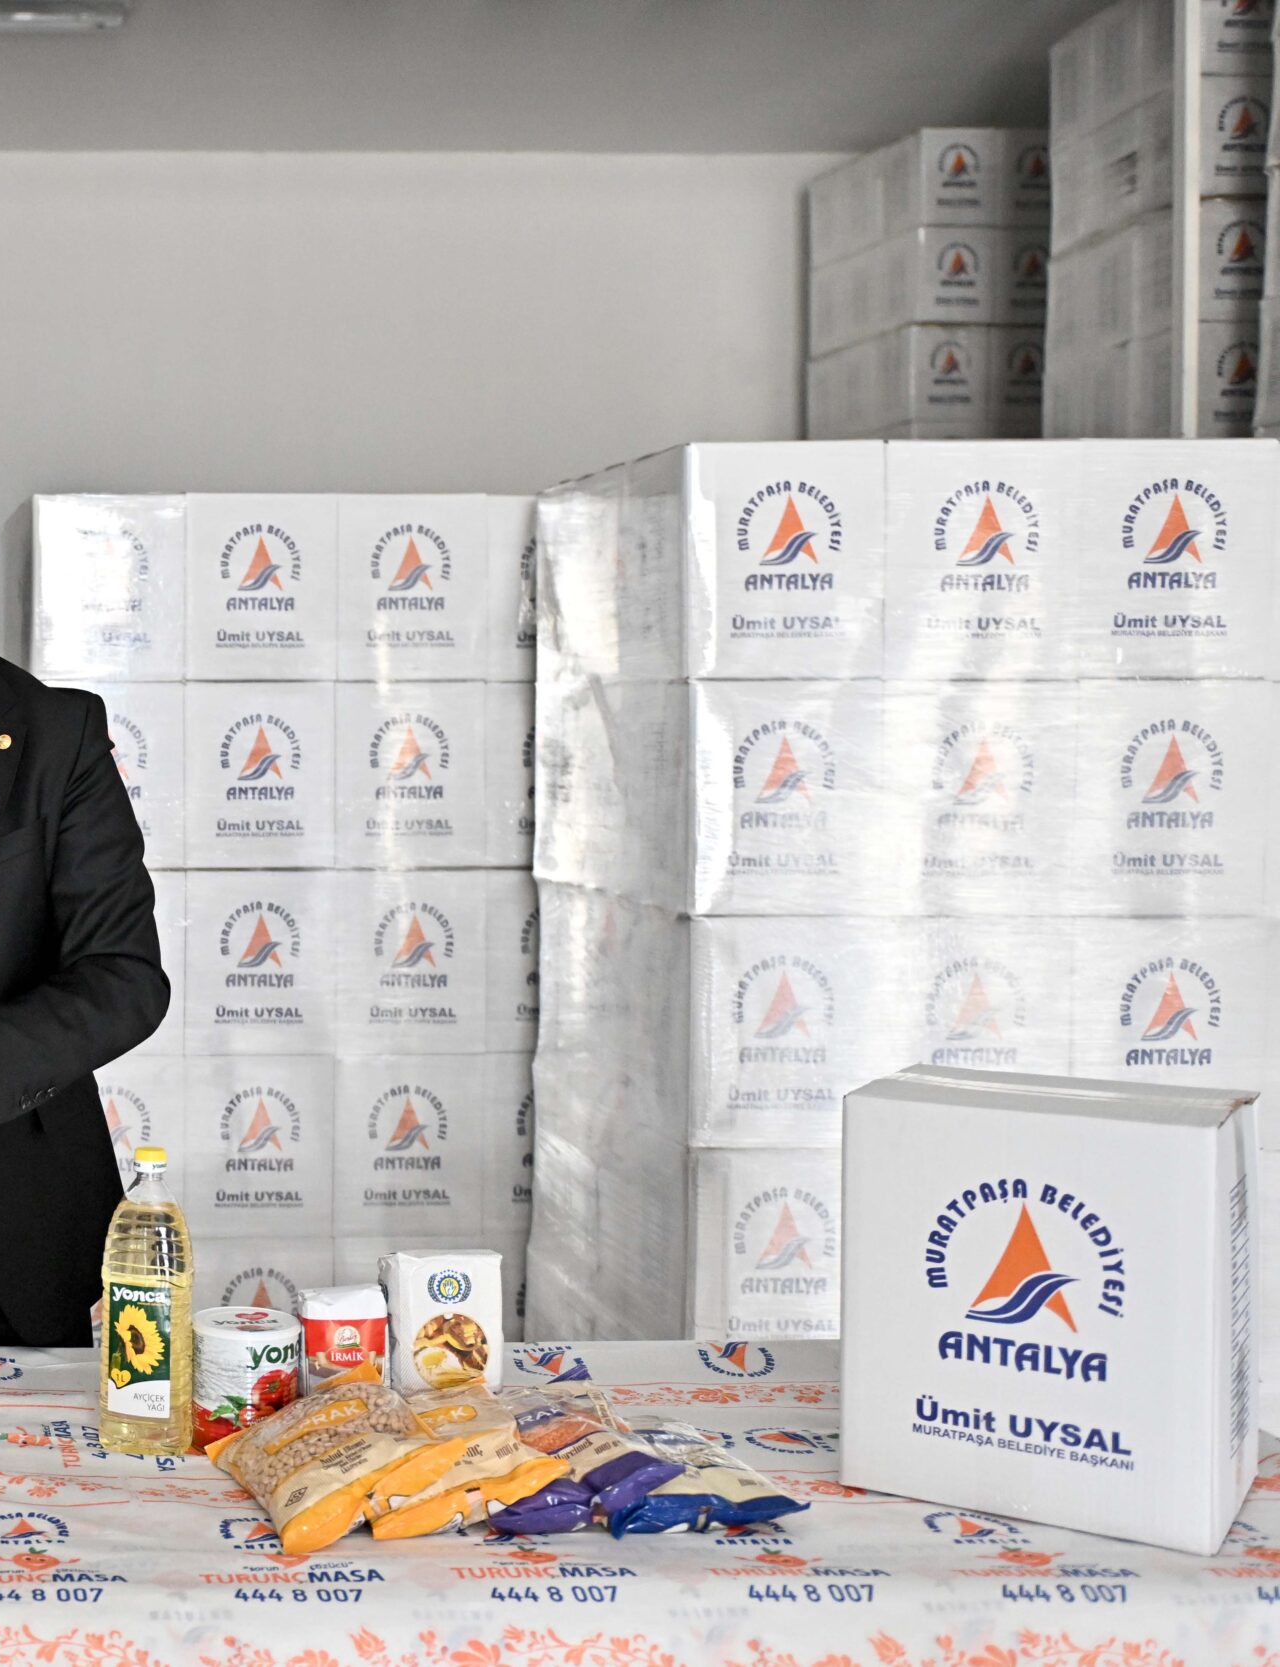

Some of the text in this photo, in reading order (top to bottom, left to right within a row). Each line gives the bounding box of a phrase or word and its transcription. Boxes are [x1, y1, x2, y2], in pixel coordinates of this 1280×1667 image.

[745, 573, 833, 591] ANTALYA
[941, 574, 1030, 591] ANTALYA
[1128, 571, 1216, 590] ANTALYA
[226, 597, 295, 611] ANTALYA
[377, 597, 445, 611] ANTALYA
[226, 786, 295, 800] ANTALYA
[1127, 812, 1214, 829] ANTALYA
[225, 974, 293, 988] ANTALYA
[1125, 1048, 1211, 1066] ANTALYA
[374, 1156, 441, 1170] ANTALYA
[925, 1178, 1125, 1318] MURATPAŞA BELEDİYESİ
[112, 1286, 167, 1303] yonca
[330, 1350, 365, 1362] İRMİK
[938, 1331, 1107, 1383] ANTALYA
[133, 1393, 165, 1403] AYÇİÇEK
[147, 1403, 165, 1412] YAĞI
[916, 1395, 1132, 1456] Ümit UYSAL
[912, 1424, 1134, 1471] MURATPAŞA BELEDİYE BAŞKANI
[32, 1588, 46, 1601] 8
[56, 1588, 104, 1601] 007
[234, 1588, 363, 1602] 444 8 007
[491, 1586, 618, 1602] 444 8 007
[748, 1585, 874, 1602] 444 8 007
[1001, 1585, 1128, 1603] 444 8 007
